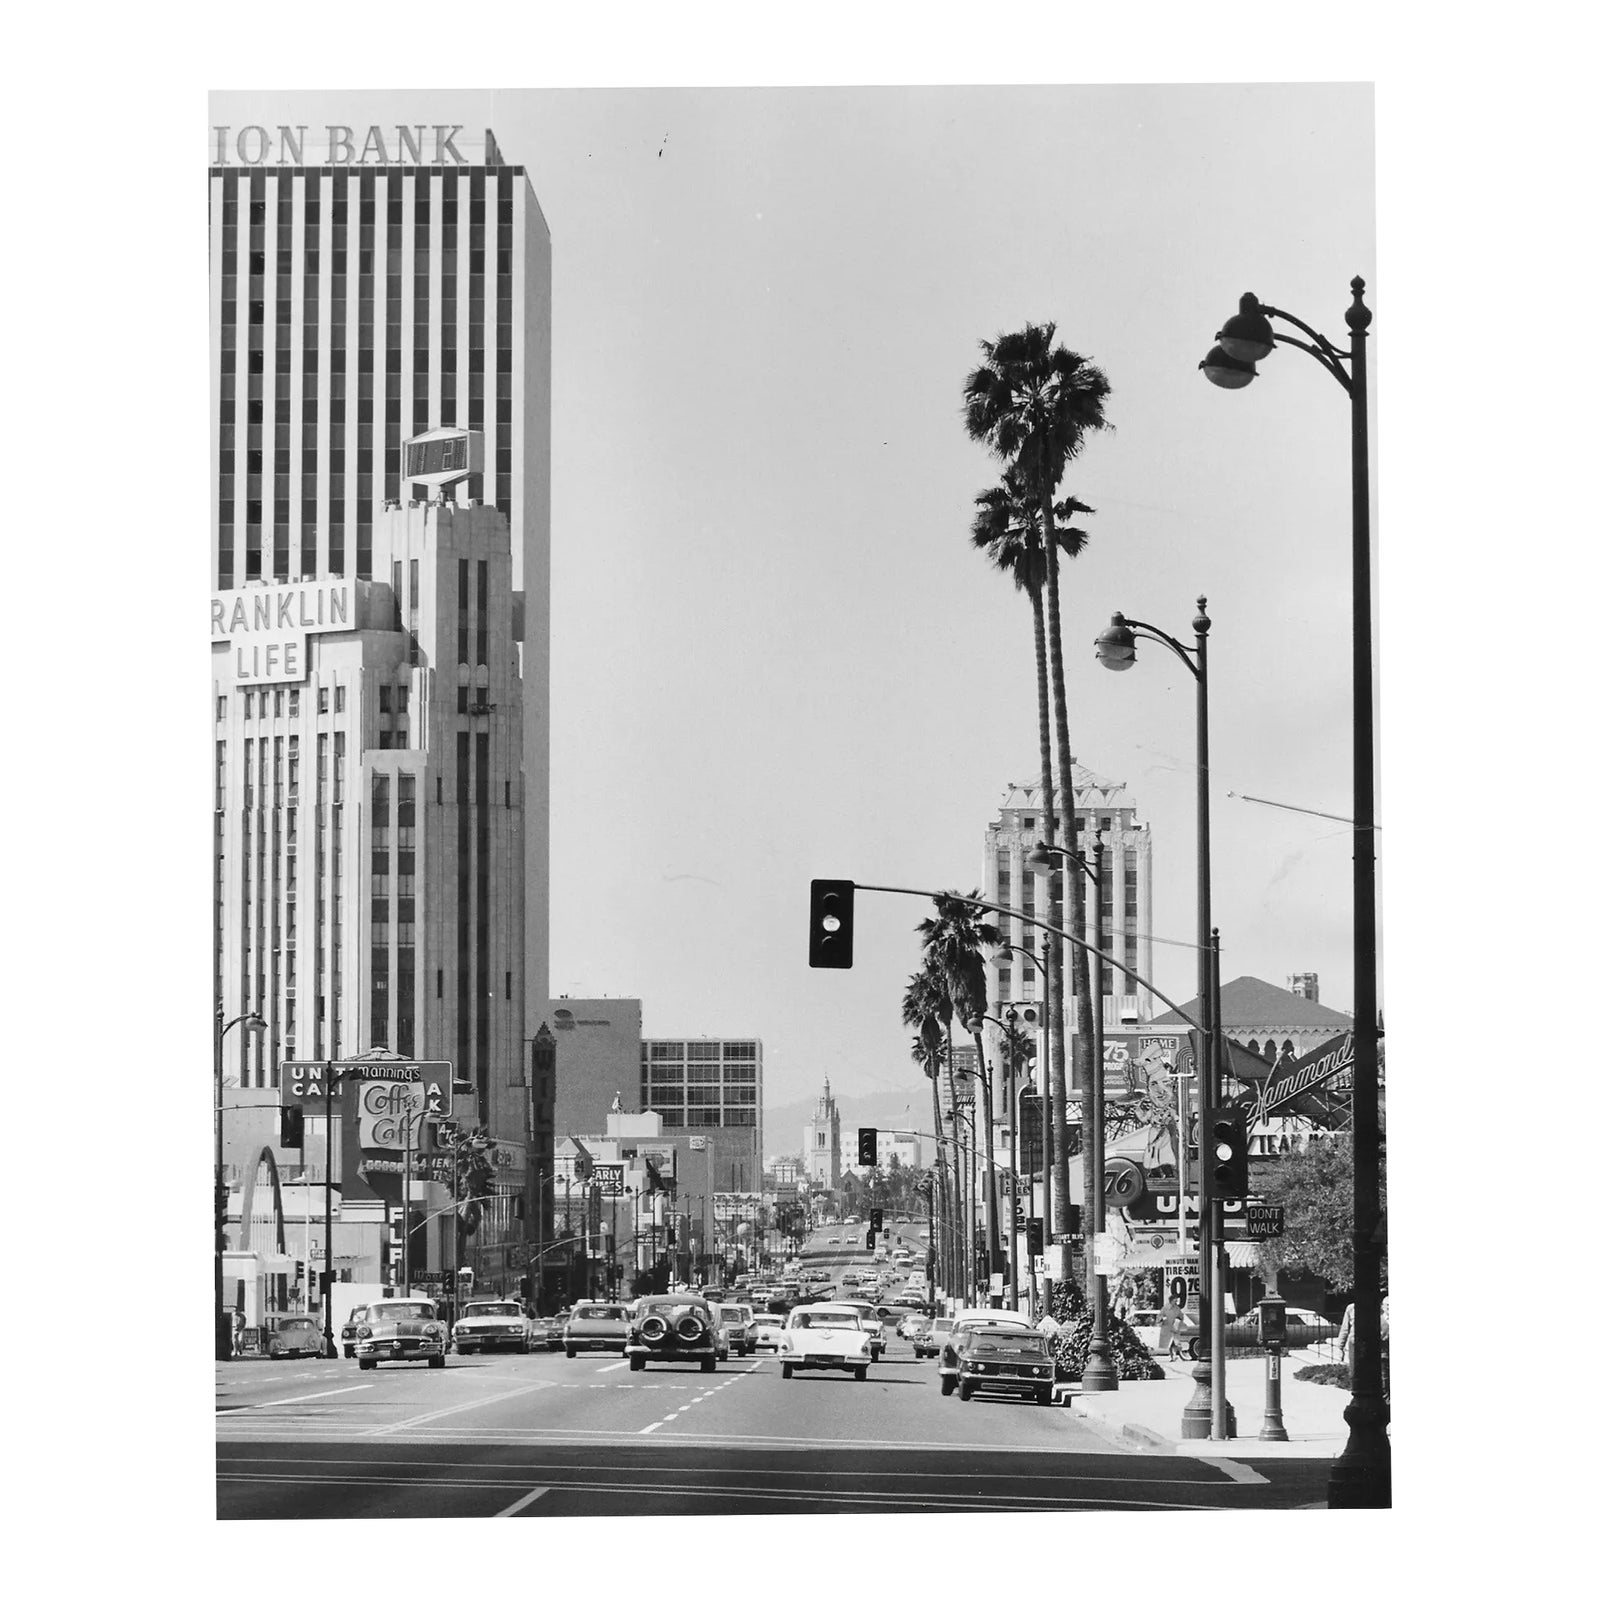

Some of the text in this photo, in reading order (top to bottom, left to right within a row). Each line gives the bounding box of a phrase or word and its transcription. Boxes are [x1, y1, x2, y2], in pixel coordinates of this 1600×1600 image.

[212, 125, 469, 165] ION BANK
[211, 587, 347, 635] RANKLIN
[237, 642, 298, 678] LIFE
[591, 1170, 621, 1180] ARLY
[1105, 1168, 1132, 1195] 76
[1156, 1195, 1265, 1212] UNO
[1249, 1208, 1280, 1219] DONT
[1249, 1223, 1280, 1234] WALK
